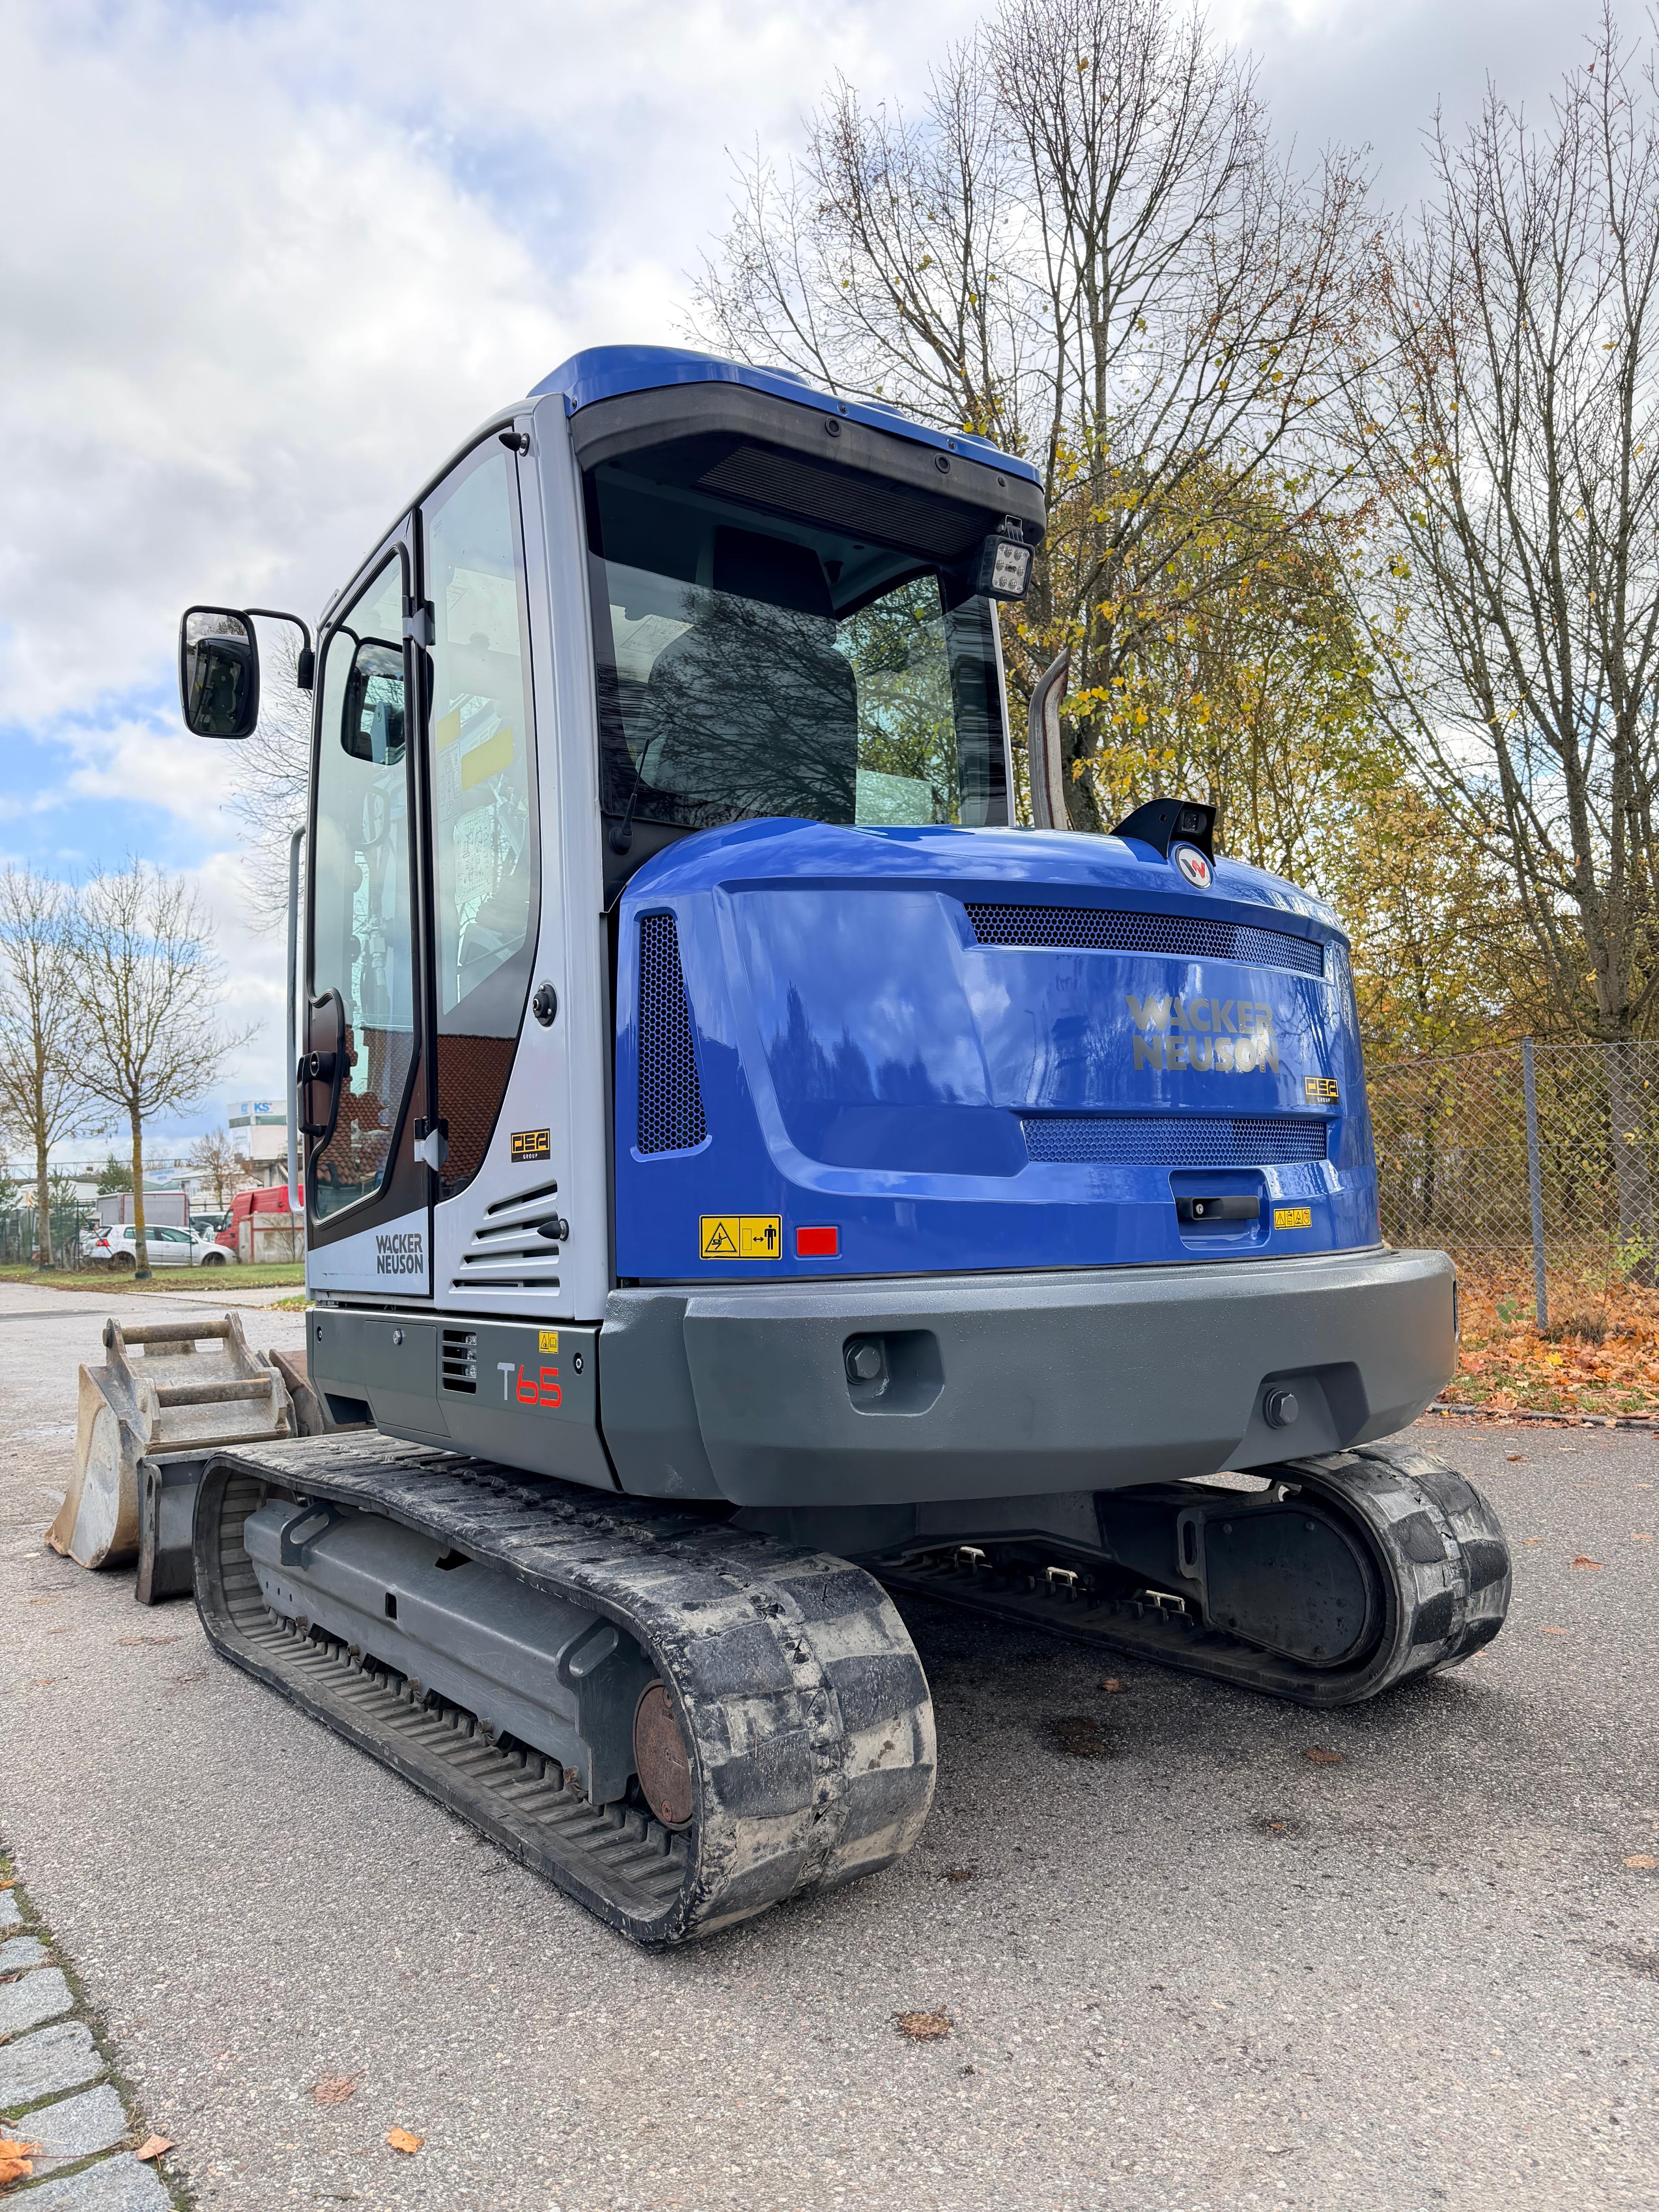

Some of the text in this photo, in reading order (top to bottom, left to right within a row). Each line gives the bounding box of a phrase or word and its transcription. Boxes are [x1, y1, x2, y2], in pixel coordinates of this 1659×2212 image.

[1125, 995, 1277, 1036] WACKER
[1132, 1035, 1280, 1074] NEUSON
[375, 1233, 423, 1254] WACKER
[377, 1254, 423, 1274] NEUSON
[497, 1362, 562, 1408] T65
